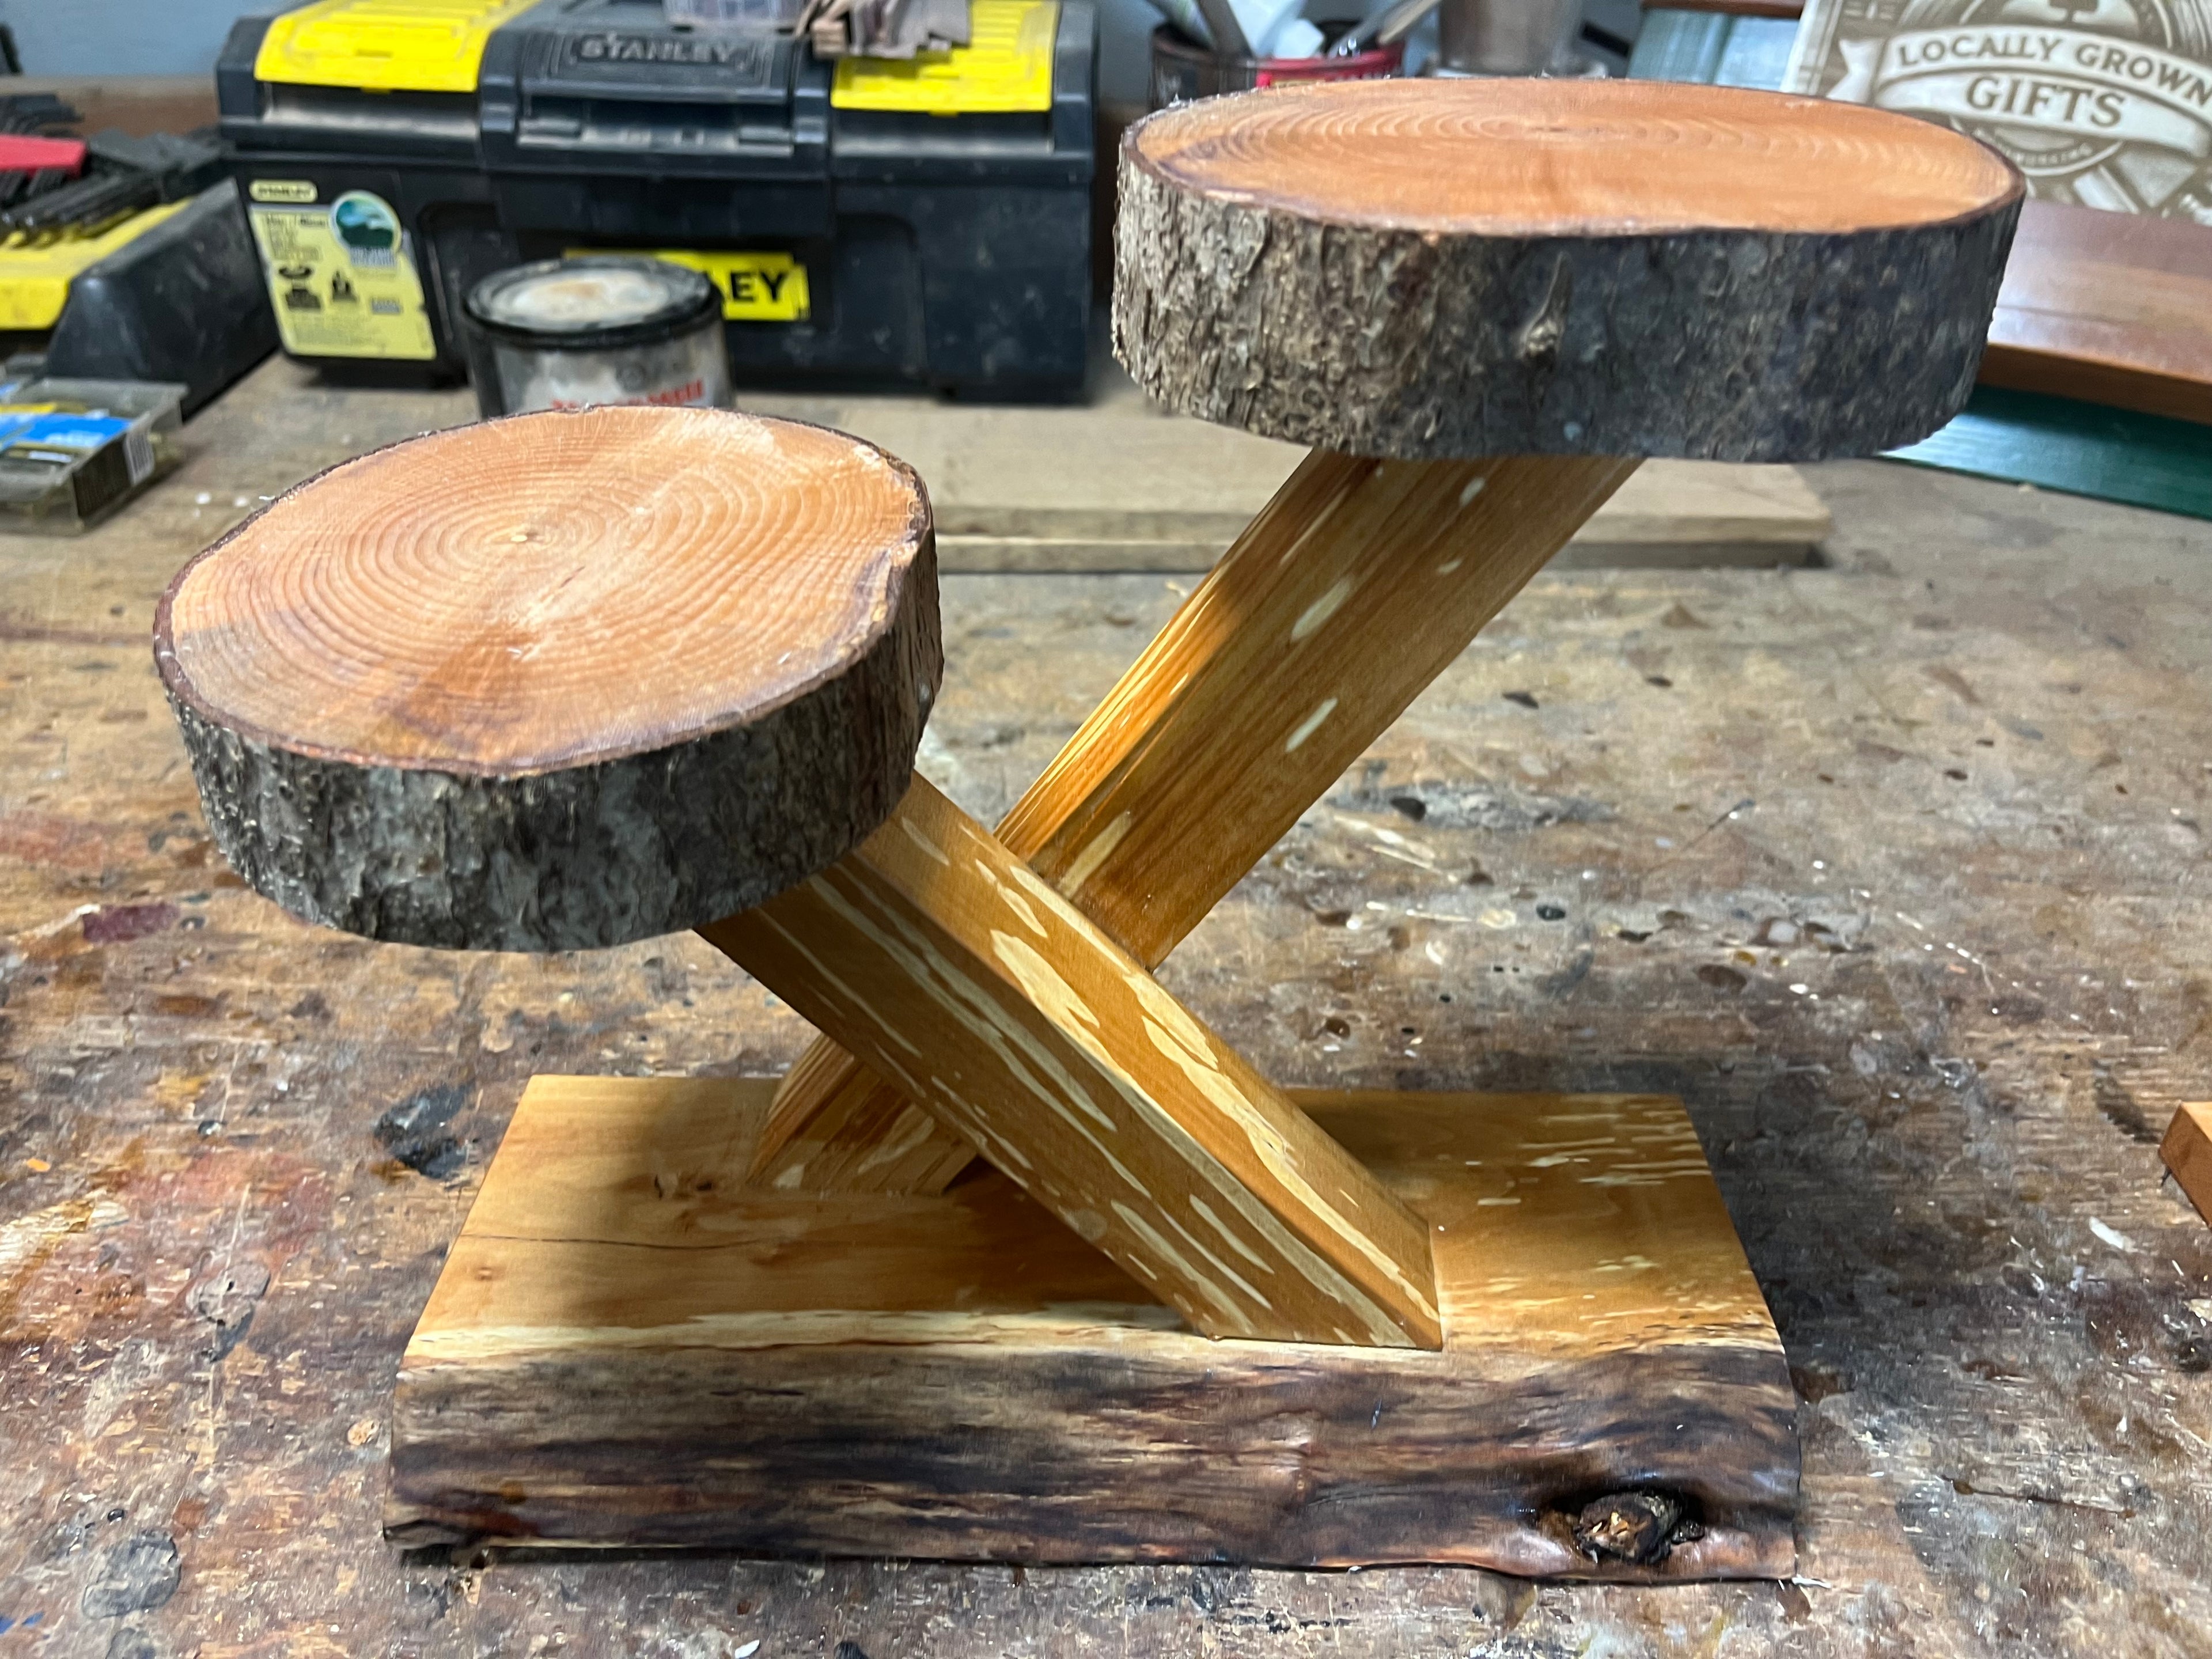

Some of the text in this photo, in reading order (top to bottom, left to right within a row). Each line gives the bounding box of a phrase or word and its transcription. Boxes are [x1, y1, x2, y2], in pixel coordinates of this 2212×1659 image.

[579, 35, 736, 63] STANLEY
[1899, 34, 2212, 107] LOCALLY GROWN
[1965, 75, 2125, 128] GIFTS
